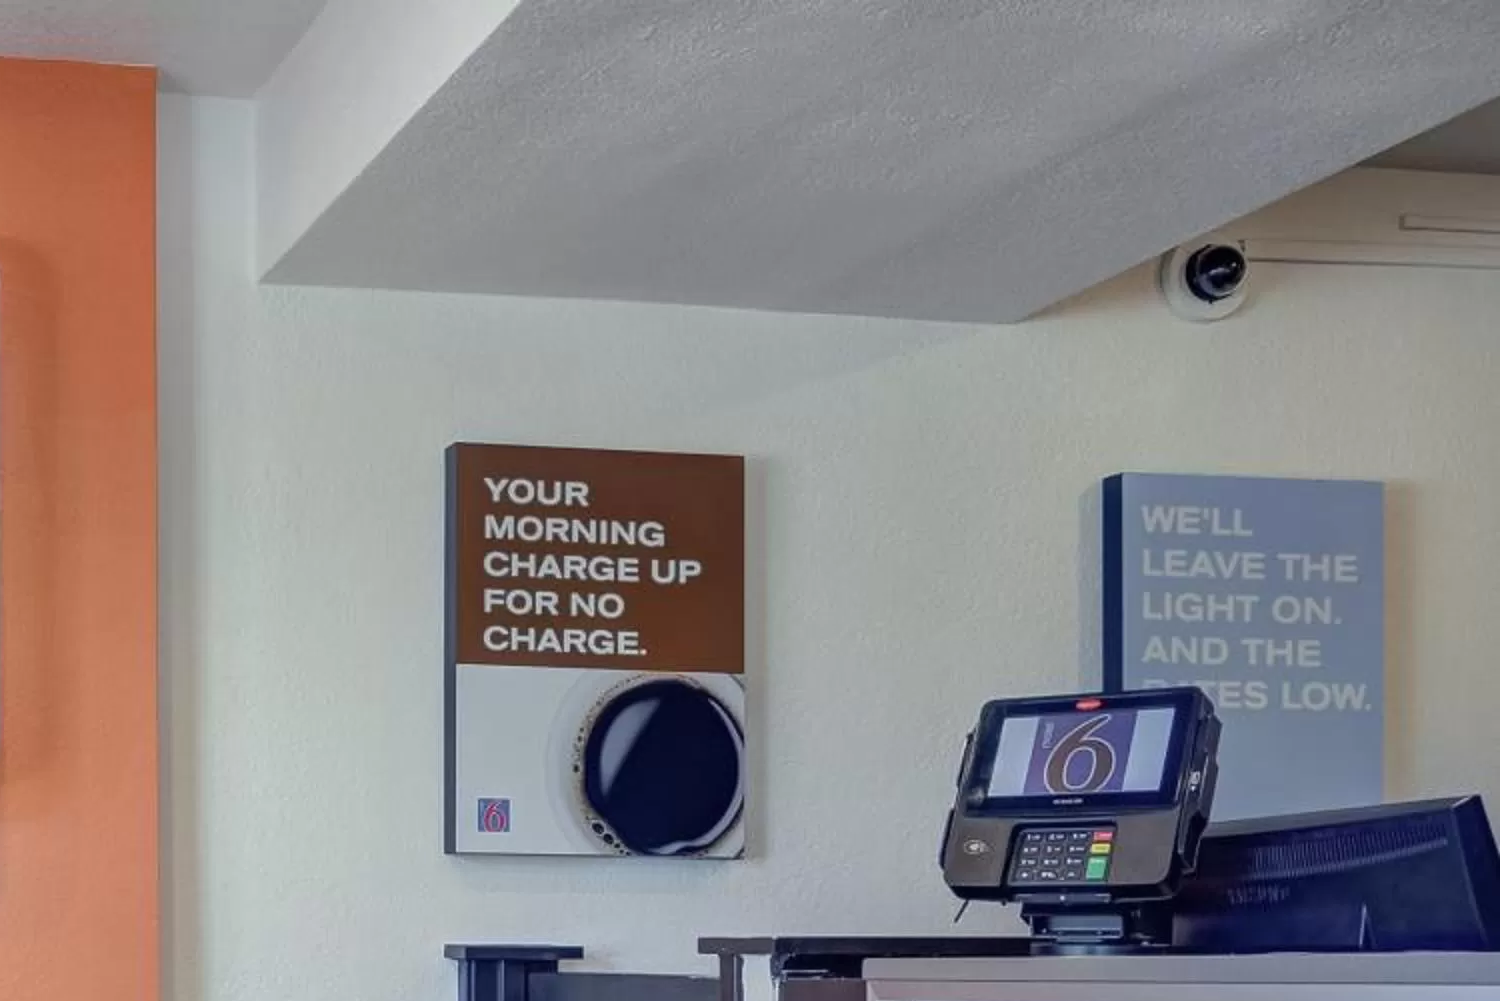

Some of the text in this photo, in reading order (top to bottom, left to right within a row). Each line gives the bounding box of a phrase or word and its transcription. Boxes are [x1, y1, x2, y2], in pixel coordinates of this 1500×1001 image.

[483, 477, 590, 507] YOUR
[484, 515, 666, 548] MORNING
[1141, 505, 1253, 538] WE'LL
[483, 552, 703, 584] CHARGE UP
[1142, 549, 1360, 583] LEAVE THE
[484, 588, 626, 619] FOR NO
[1142, 592, 1342, 625] LIGHT ON.
[483, 626, 648, 657] CHARGE.
[1141, 636, 1322, 667] AND THE
[1282, 682, 1373, 711] LOW.
[1044, 714, 1116, 794] 6
[484, 800, 507, 832] 6
